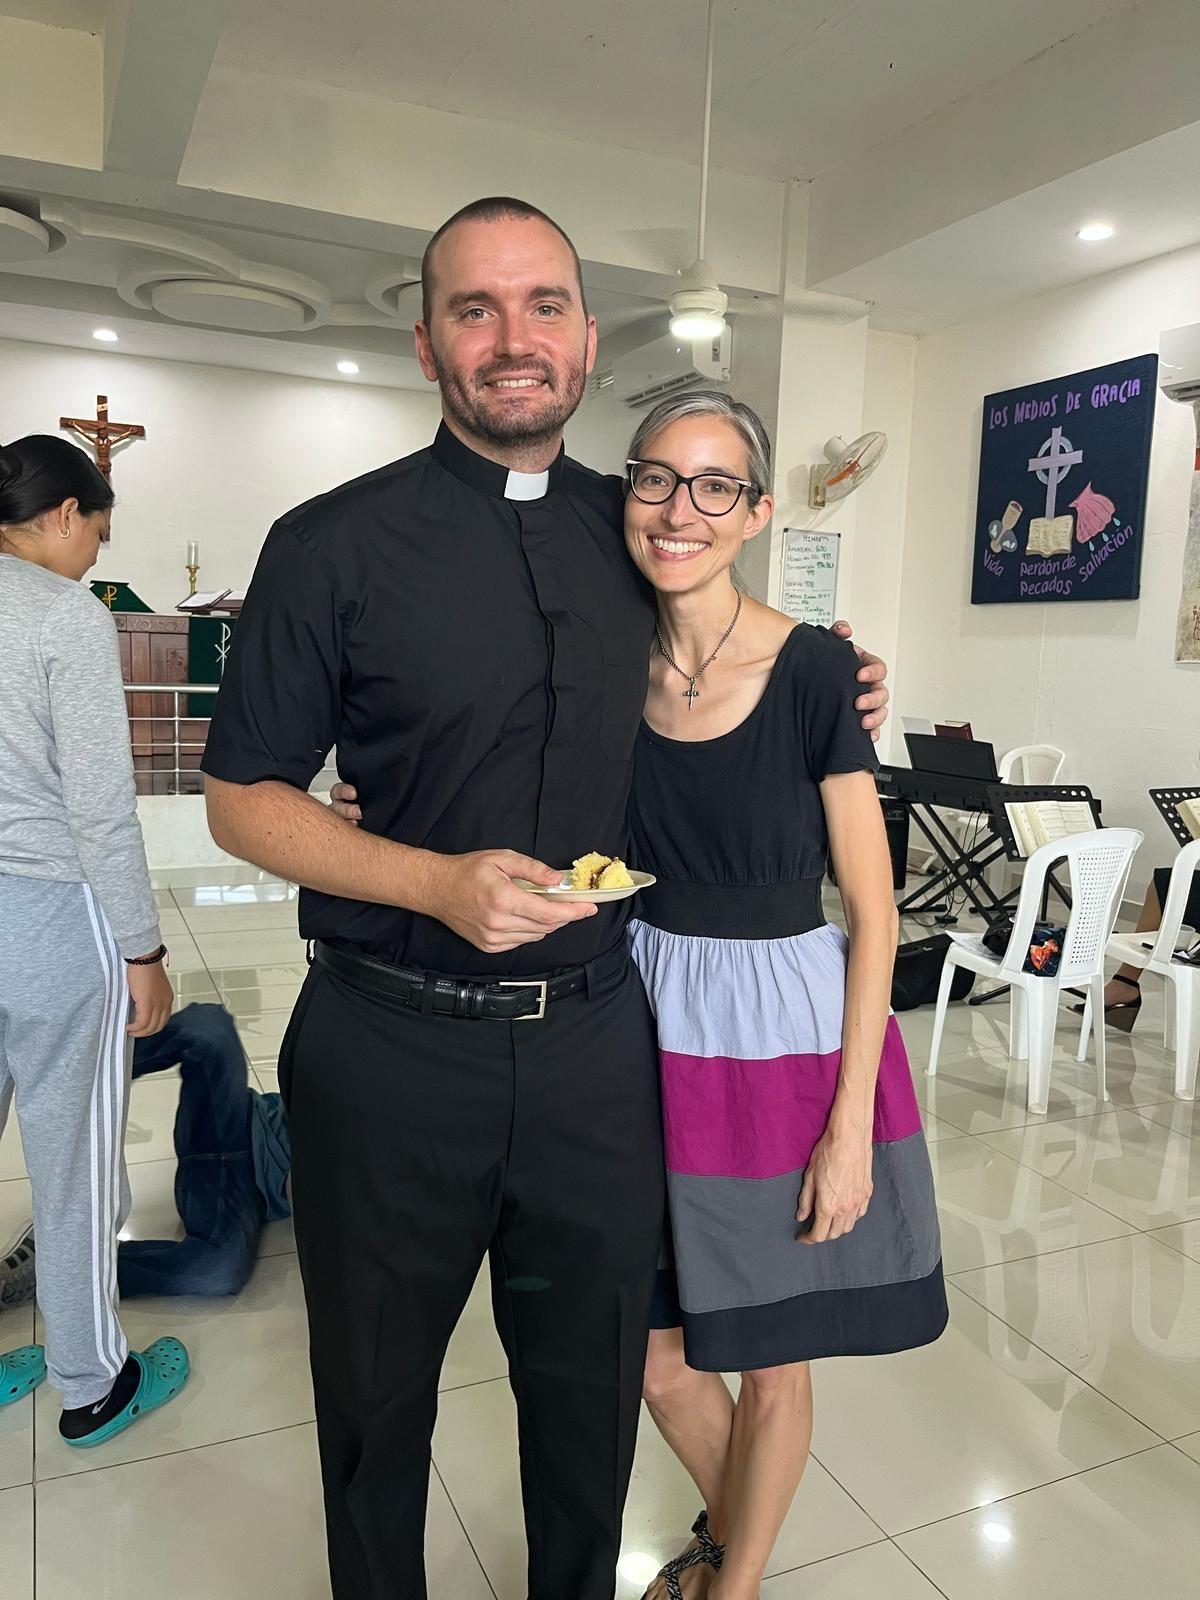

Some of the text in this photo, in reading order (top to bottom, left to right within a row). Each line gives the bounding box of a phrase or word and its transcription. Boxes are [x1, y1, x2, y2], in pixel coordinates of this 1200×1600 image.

[989, 378, 1141, 430] LOS MEDIOS DE GRACIA
[983, 549, 1005, 577] Vida
[1061, 554, 1077, 570] de
[1079, 524, 1134, 582] Salvación
